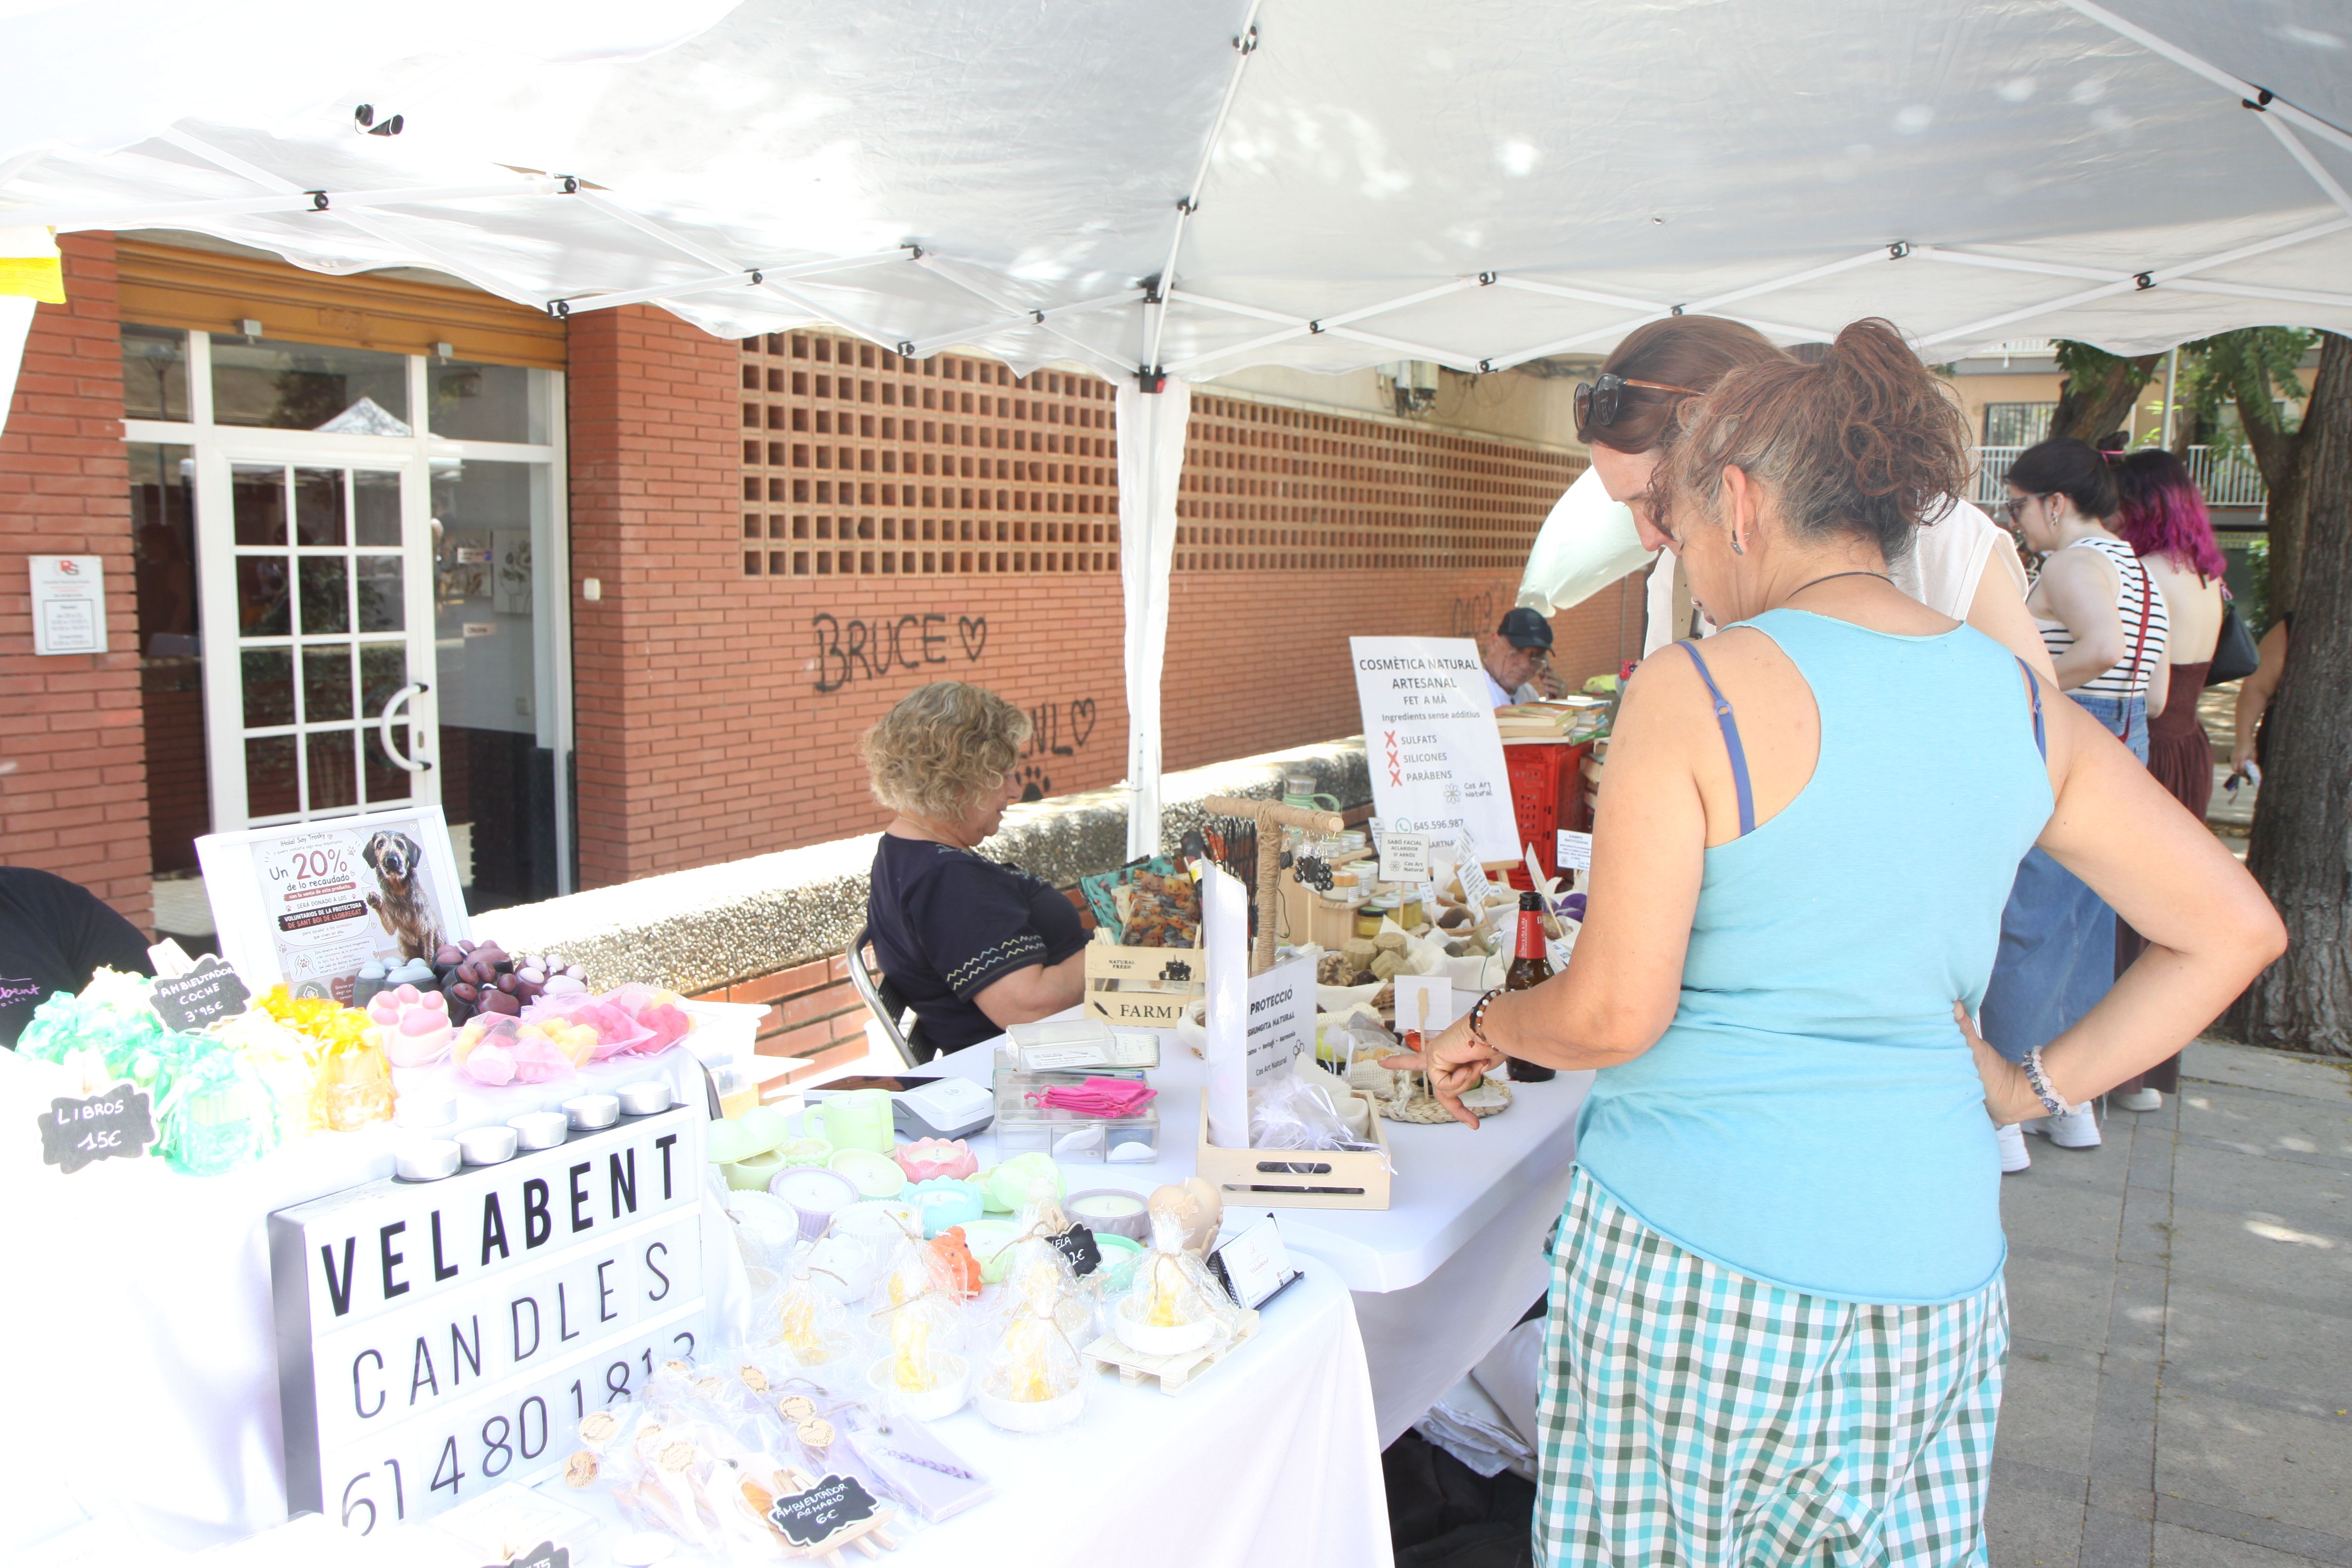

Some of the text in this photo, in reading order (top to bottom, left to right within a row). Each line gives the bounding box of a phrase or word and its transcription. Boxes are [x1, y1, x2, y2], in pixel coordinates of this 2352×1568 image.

[813, 613, 946, 692] BRUCE
[1360, 656, 1478, 670] COSMÈTICA NATURAL
[1392, 678, 1458, 689] ARTESANAL
[1404, 693, 1447, 705] FET A MÀ
[1382, 713, 1426, 723] Ingredients
[1451, 710, 1480, 719] additius
[1401, 735, 1437, 745] SULFATS
[1404, 752, 1447, 763] SILICONES
[1406, 770, 1452, 782] PARÀBENS
[1465, 789, 1493, 797] Natural
[1414, 818, 1464, 831] 645.596.987
[269, 848, 347, 881] Un 20%
[287, 874, 350, 891] de lo recaudado
[296, 900, 310, 909] SERÁ
[311, 898, 332, 906] DONADO
[284, 911, 318, 922] VOLUNTARIOS
[333, 902, 362, 913] PROTECTORA
[332, 909, 362, 920] LLOBREGAT
[0, 984, 41, 999] bent
[180, 982, 220, 1005] COCHE
[1250, 984, 1293, 1015] PROTECCIÓ
[1120, 1004, 1172, 1019] FARM
[1247, 1011, 1295, 1037] SHUNGITA NATURAL
[1272, 1056, 1287, 1069] Natural
[58, 1099, 124, 1125] LIBROS
[78, 1130, 122, 1150] 15€
[321, 1133, 677, 1317] VELABENT
[352, 1242, 670, 1419] CANDLES
[797, 1494, 844, 1519] ARMARIO
[816, 1509, 839, 1524] 6€
